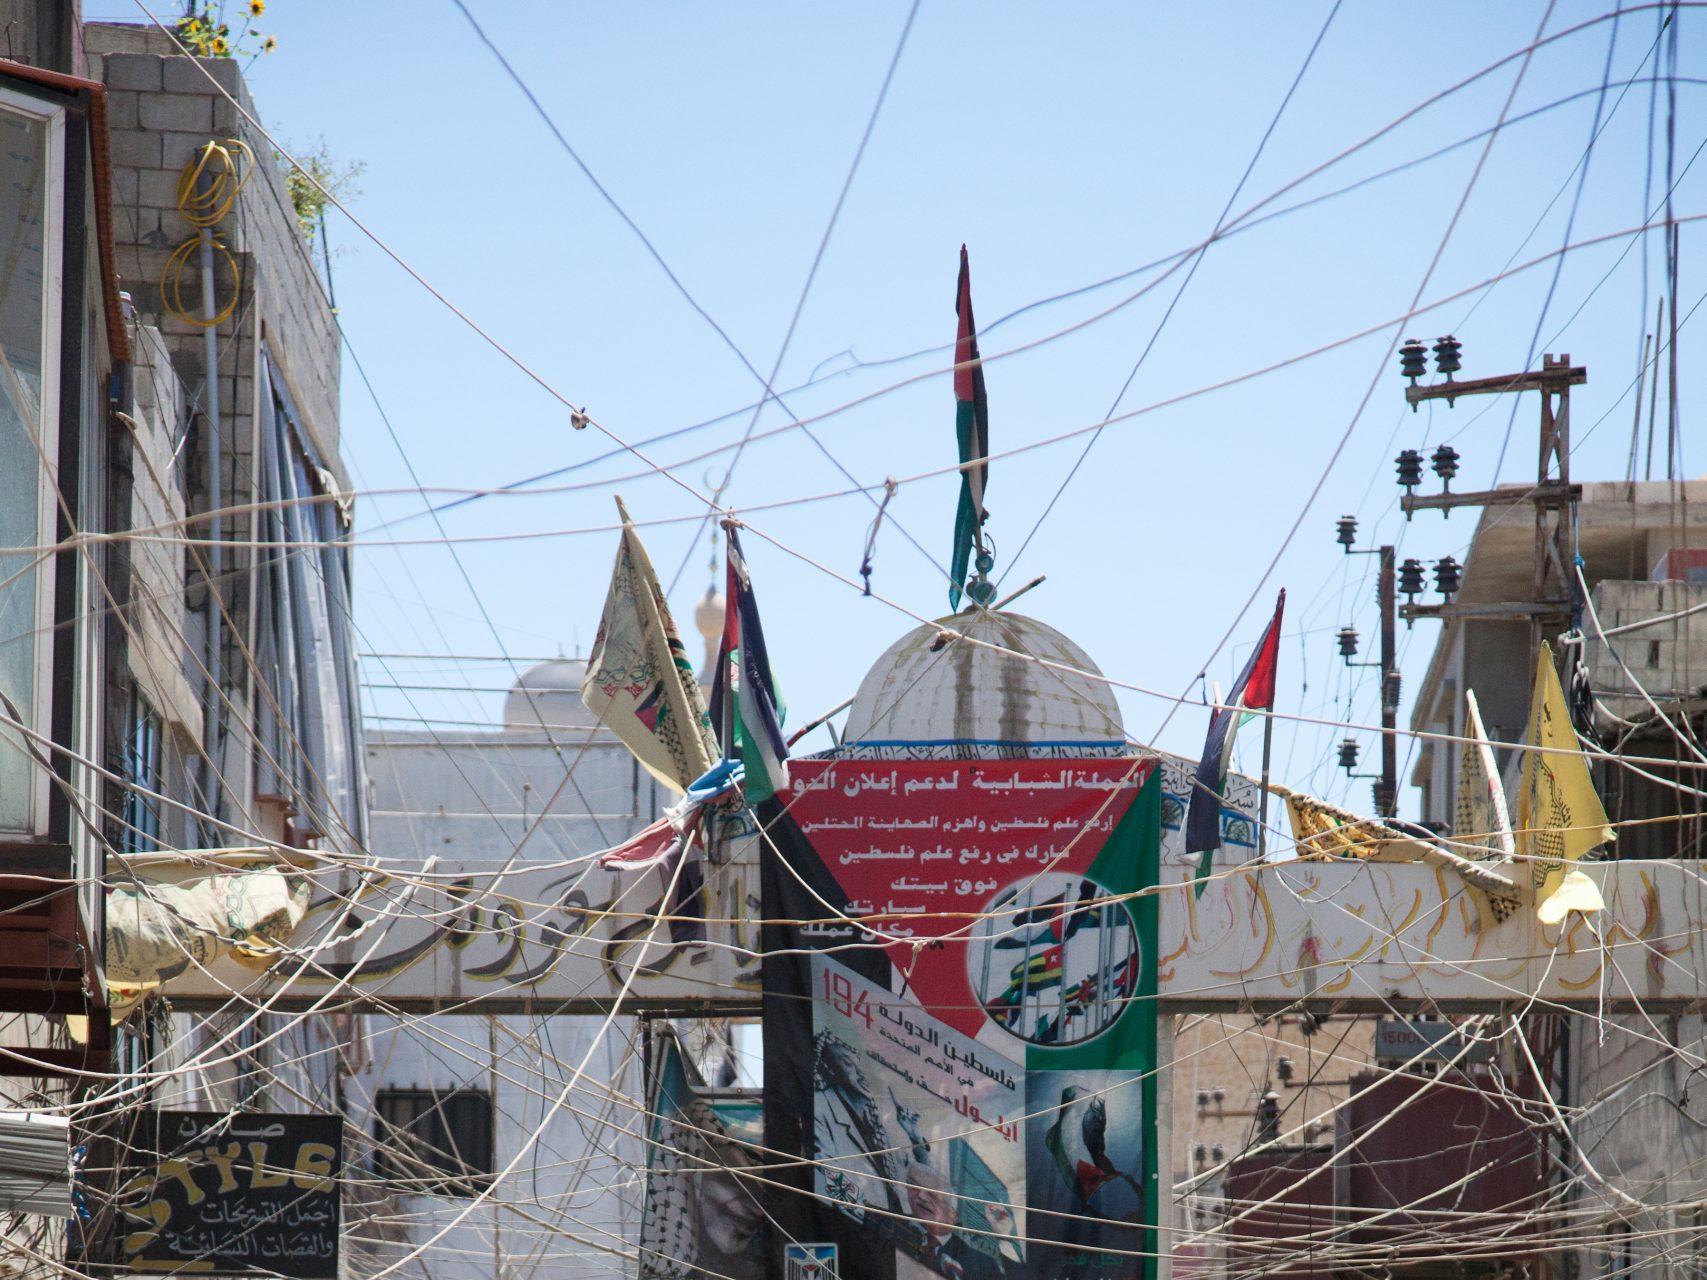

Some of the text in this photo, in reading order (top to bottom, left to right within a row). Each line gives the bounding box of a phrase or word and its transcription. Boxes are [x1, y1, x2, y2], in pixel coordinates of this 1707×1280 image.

[788, 770, 837, 797] الدو
[843, 769, 898, 798] إعلان
[904, 769, 959, 797] لدعم
[971, 769, 1073, 797] الشبابية
[1074, 769, 1145, 793] الحملة
[801, 815, 864, 833] المحتلين
[867, 815, 939, 832] الصهاينة
[943, 815, 987, 832] واهزم
[990, 815, 1050, 832] فلسطين
[1053, 816, 1080, 832] علم
[838, 843, 1070, 865] شارك في رفع علم فلسطين
[890, 875, 999, 896] فوق بيتك
[800, 920, 915, 942] مكان عملك
[822, 967, 1016, 1092] فلسطين الدولة 194
[879, 1026, 975, 1088] في الأمم المتحدة
[178, 1115, 286, 1144] صالون
